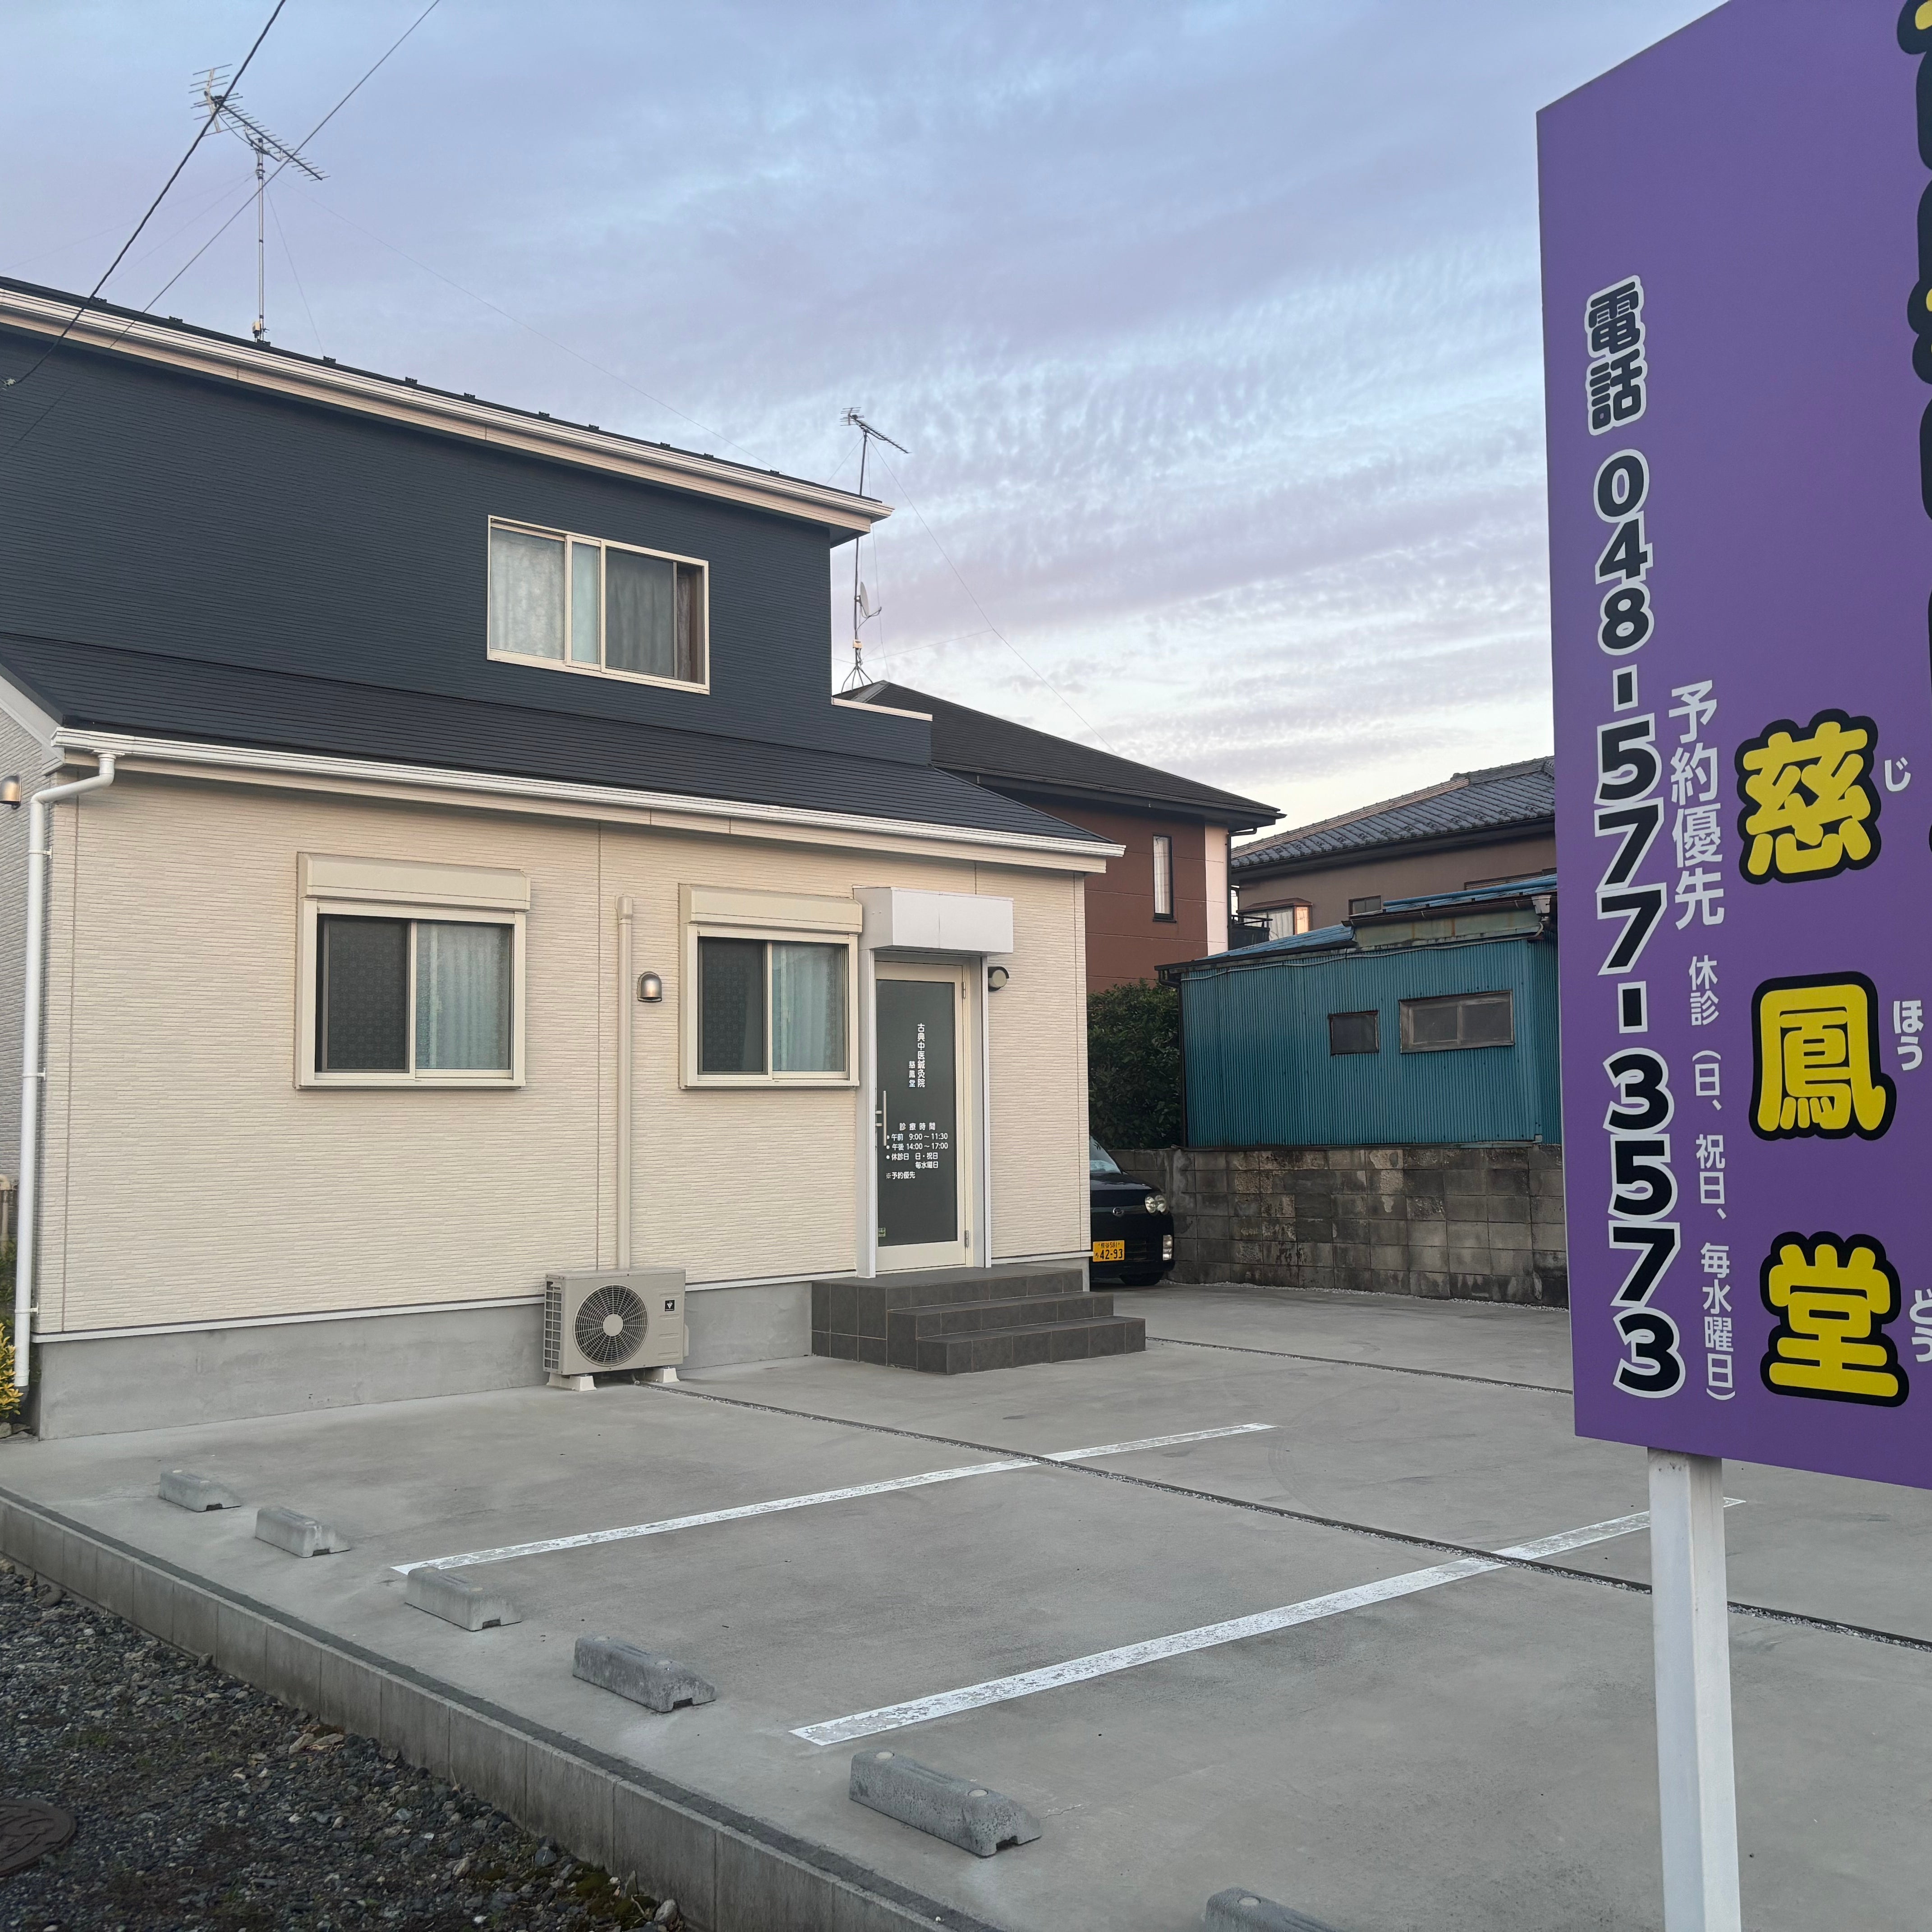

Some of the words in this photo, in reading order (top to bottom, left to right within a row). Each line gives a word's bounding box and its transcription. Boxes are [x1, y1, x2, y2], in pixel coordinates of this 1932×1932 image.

[1584, 275, 1647, 436] 電話
[1669, 680, 1725, 930] 予約優先
[1884, 757, 1911, 791] じ
[1594, 449, 1685, 1398] 048-577-3573
[1734, 708, 1909, 1408] 慈鳳堂
[1893, 1000, 1924, 1071] ほう
[891, 1153, 909, 1161] 休診日
[1100, 1248, 1123, 1260] 42-93
